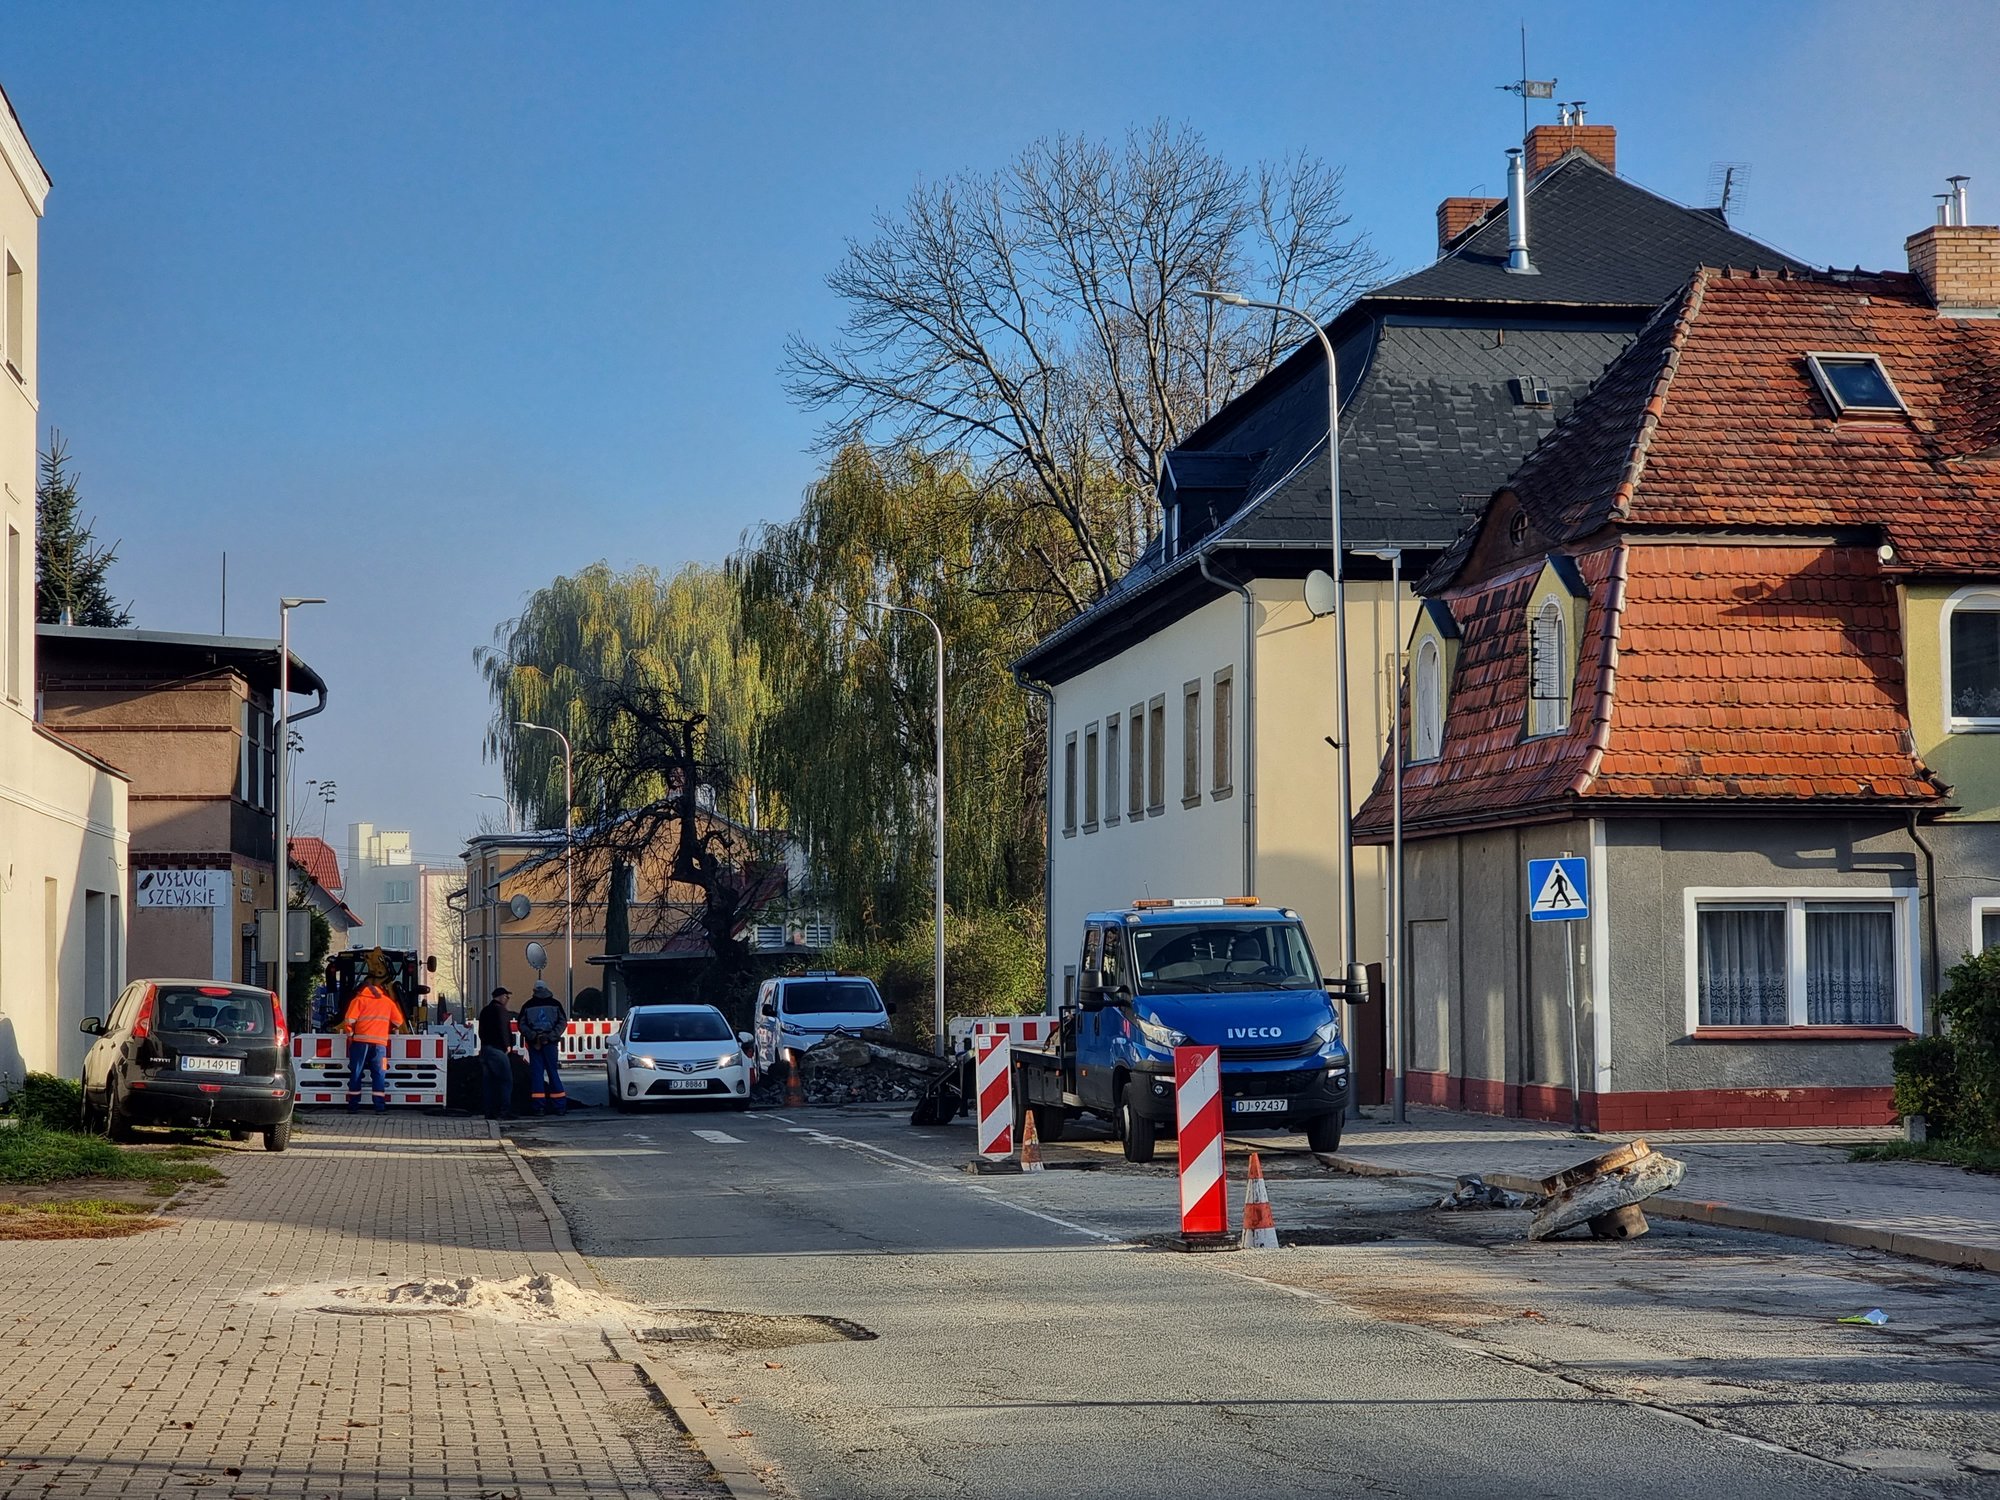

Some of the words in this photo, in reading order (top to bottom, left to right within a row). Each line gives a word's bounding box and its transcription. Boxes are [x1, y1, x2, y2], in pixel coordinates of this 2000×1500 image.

[1227, 1027, 1282, 1039] IVECO
[188, 1058, 201, 1069] DJ
[207, 1059, 237, 1071] 1491E
[1237, 1101, 1251, 1111] DJ
[1254, 1100, 1286, 1111] 92437
